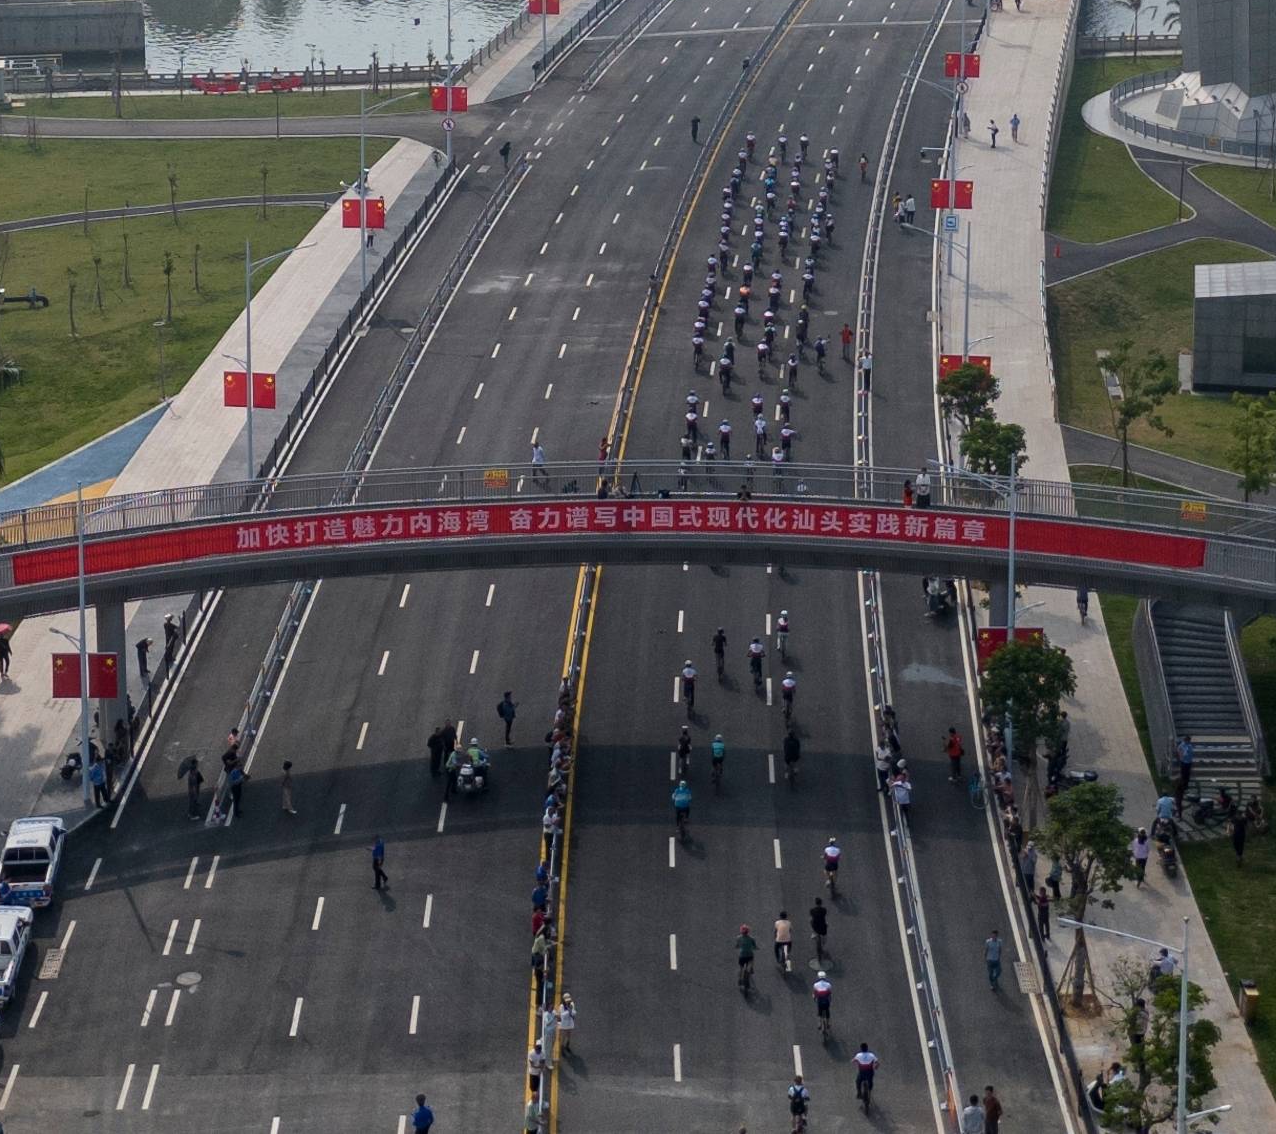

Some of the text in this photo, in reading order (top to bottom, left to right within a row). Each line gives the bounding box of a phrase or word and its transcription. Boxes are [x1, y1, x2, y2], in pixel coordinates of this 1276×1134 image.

[236, 506, 986, 549] 加快打造魅力内海湾 奋力谱写中国式现代化汕头实践新篇章
